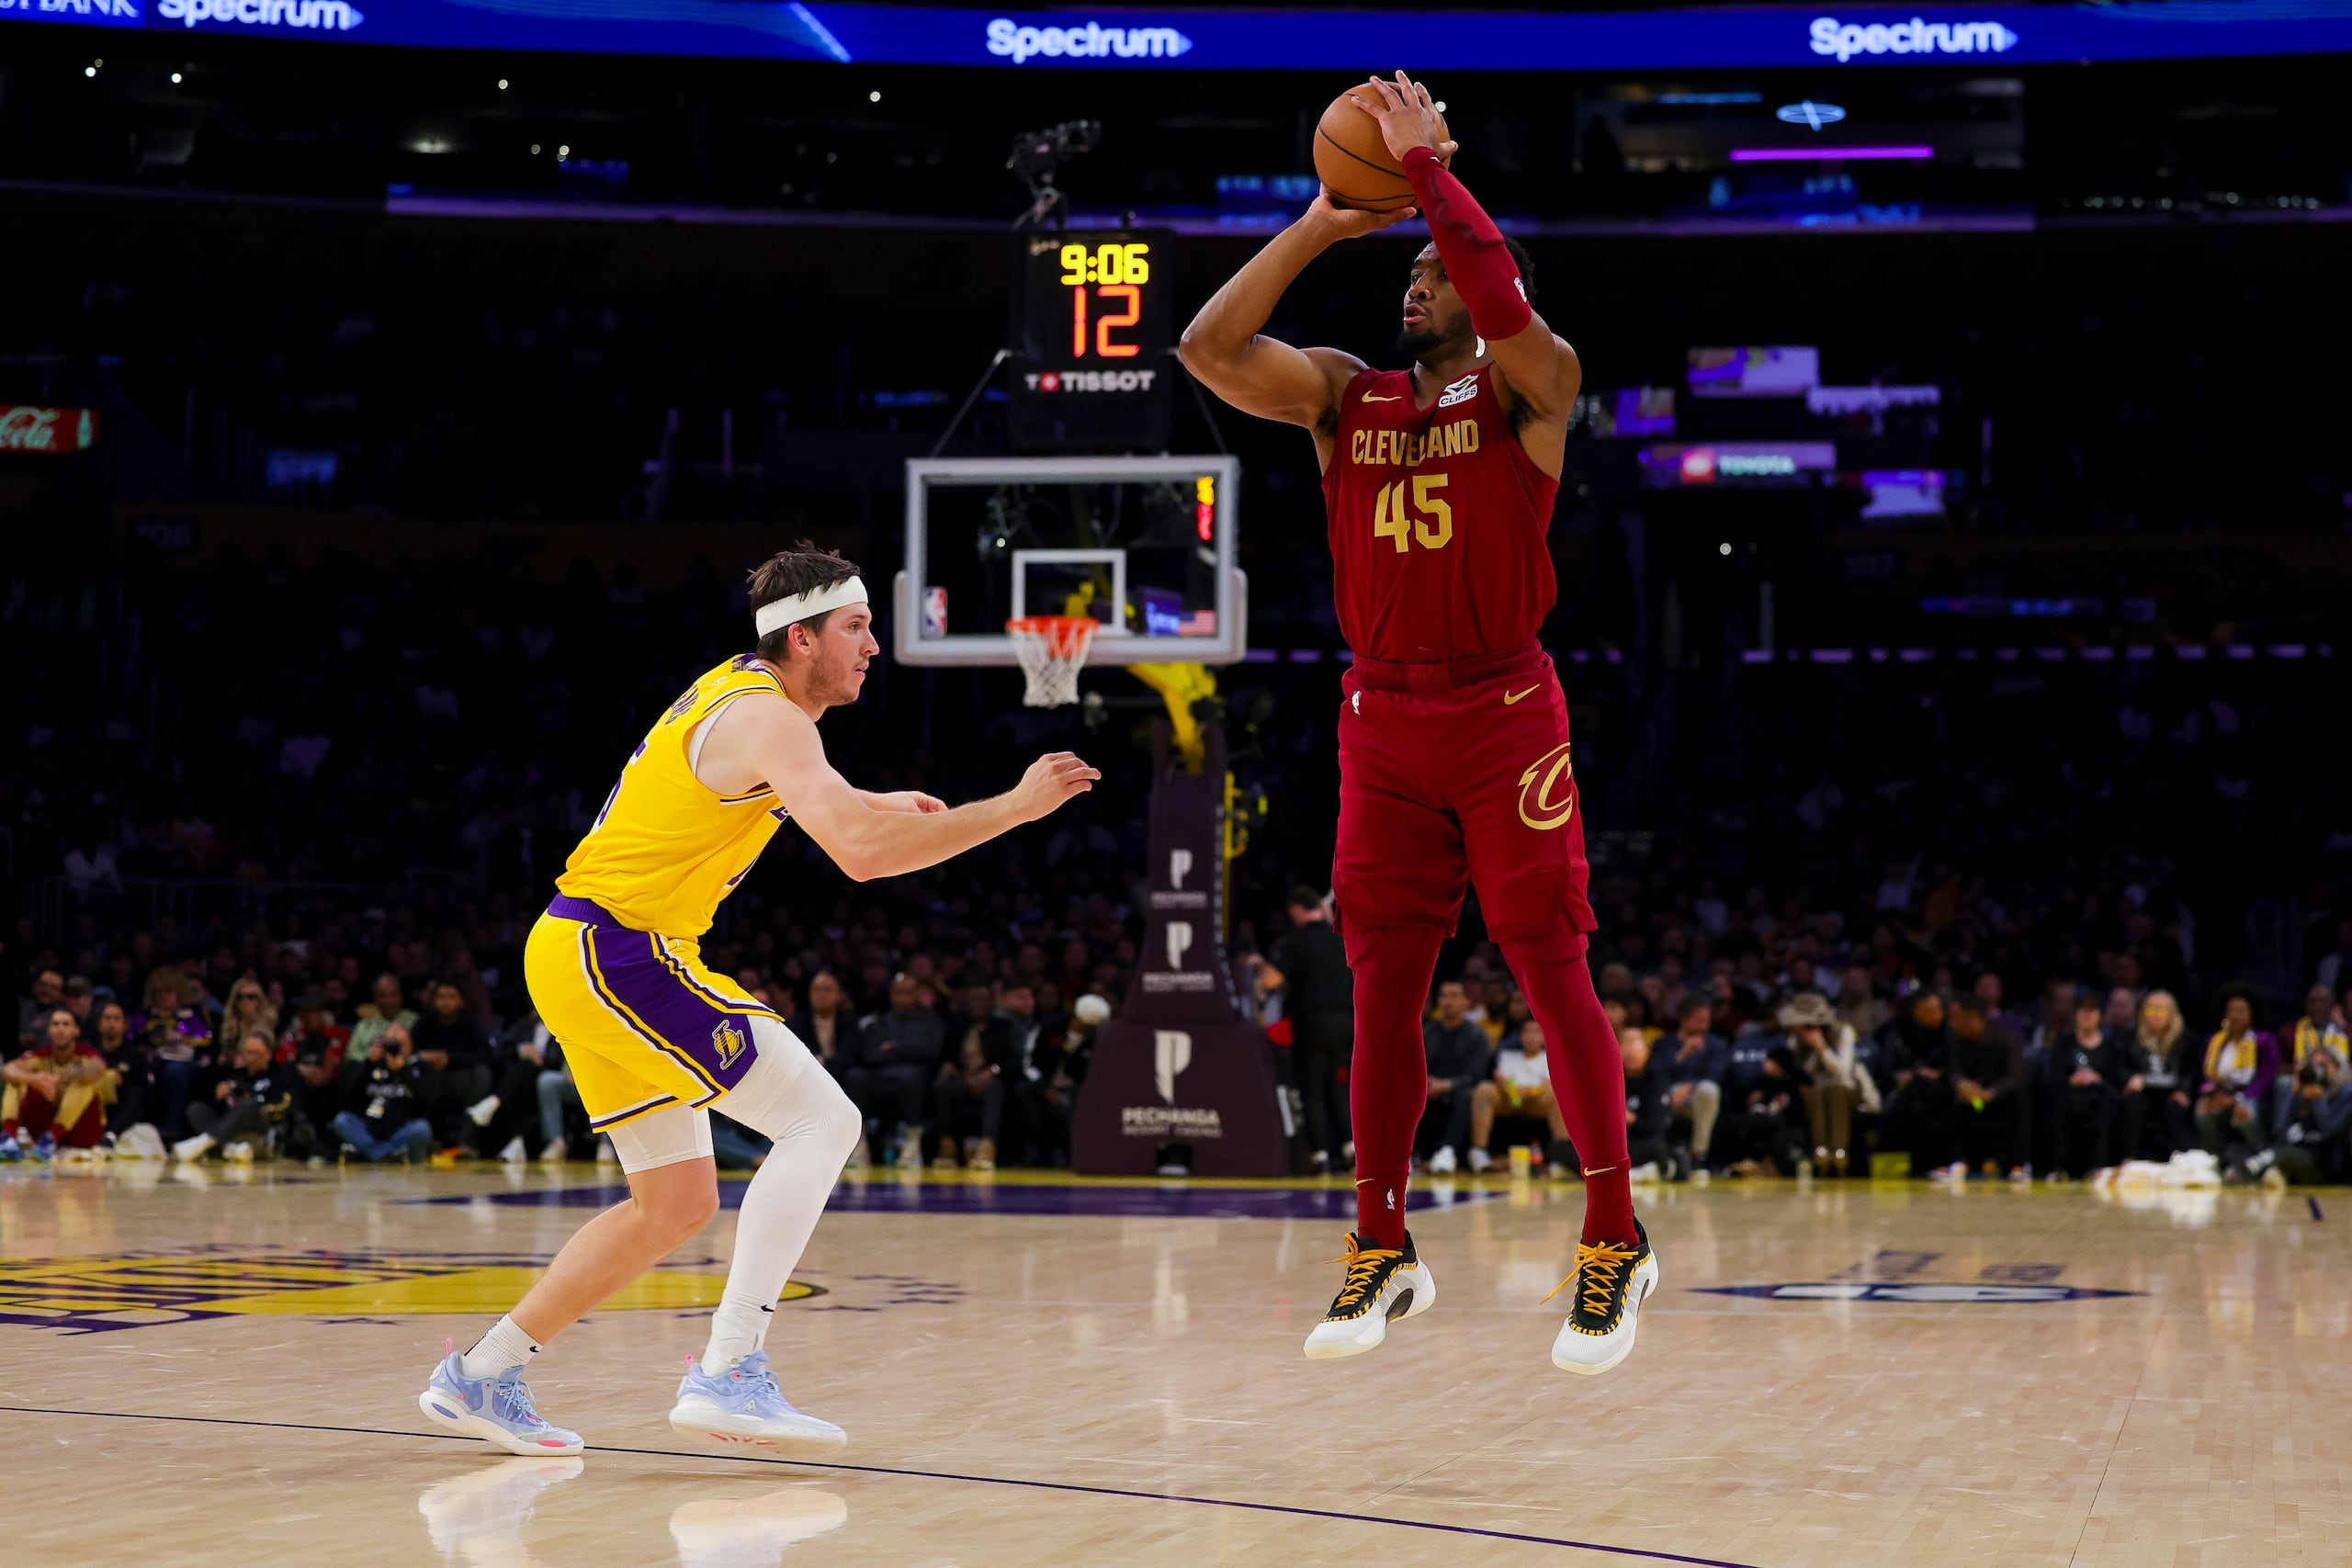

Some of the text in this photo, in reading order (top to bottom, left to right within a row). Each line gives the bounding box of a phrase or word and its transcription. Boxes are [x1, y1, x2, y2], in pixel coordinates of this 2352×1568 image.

[986, 17, 1181, 64] Spectrum
[1809, 17, 2007, 63] Spectrum
[1060, 243, 1149, 286] 9:06
[1073, 285, 1140, 357] 12
[1061, 370, 1156, 391] TISSOT
[1440, 387, 1477, 405] CLIFFS
[1351, 419, 1479, 467] CLEVELAND
[1374, 473, 1453, 553] 45
